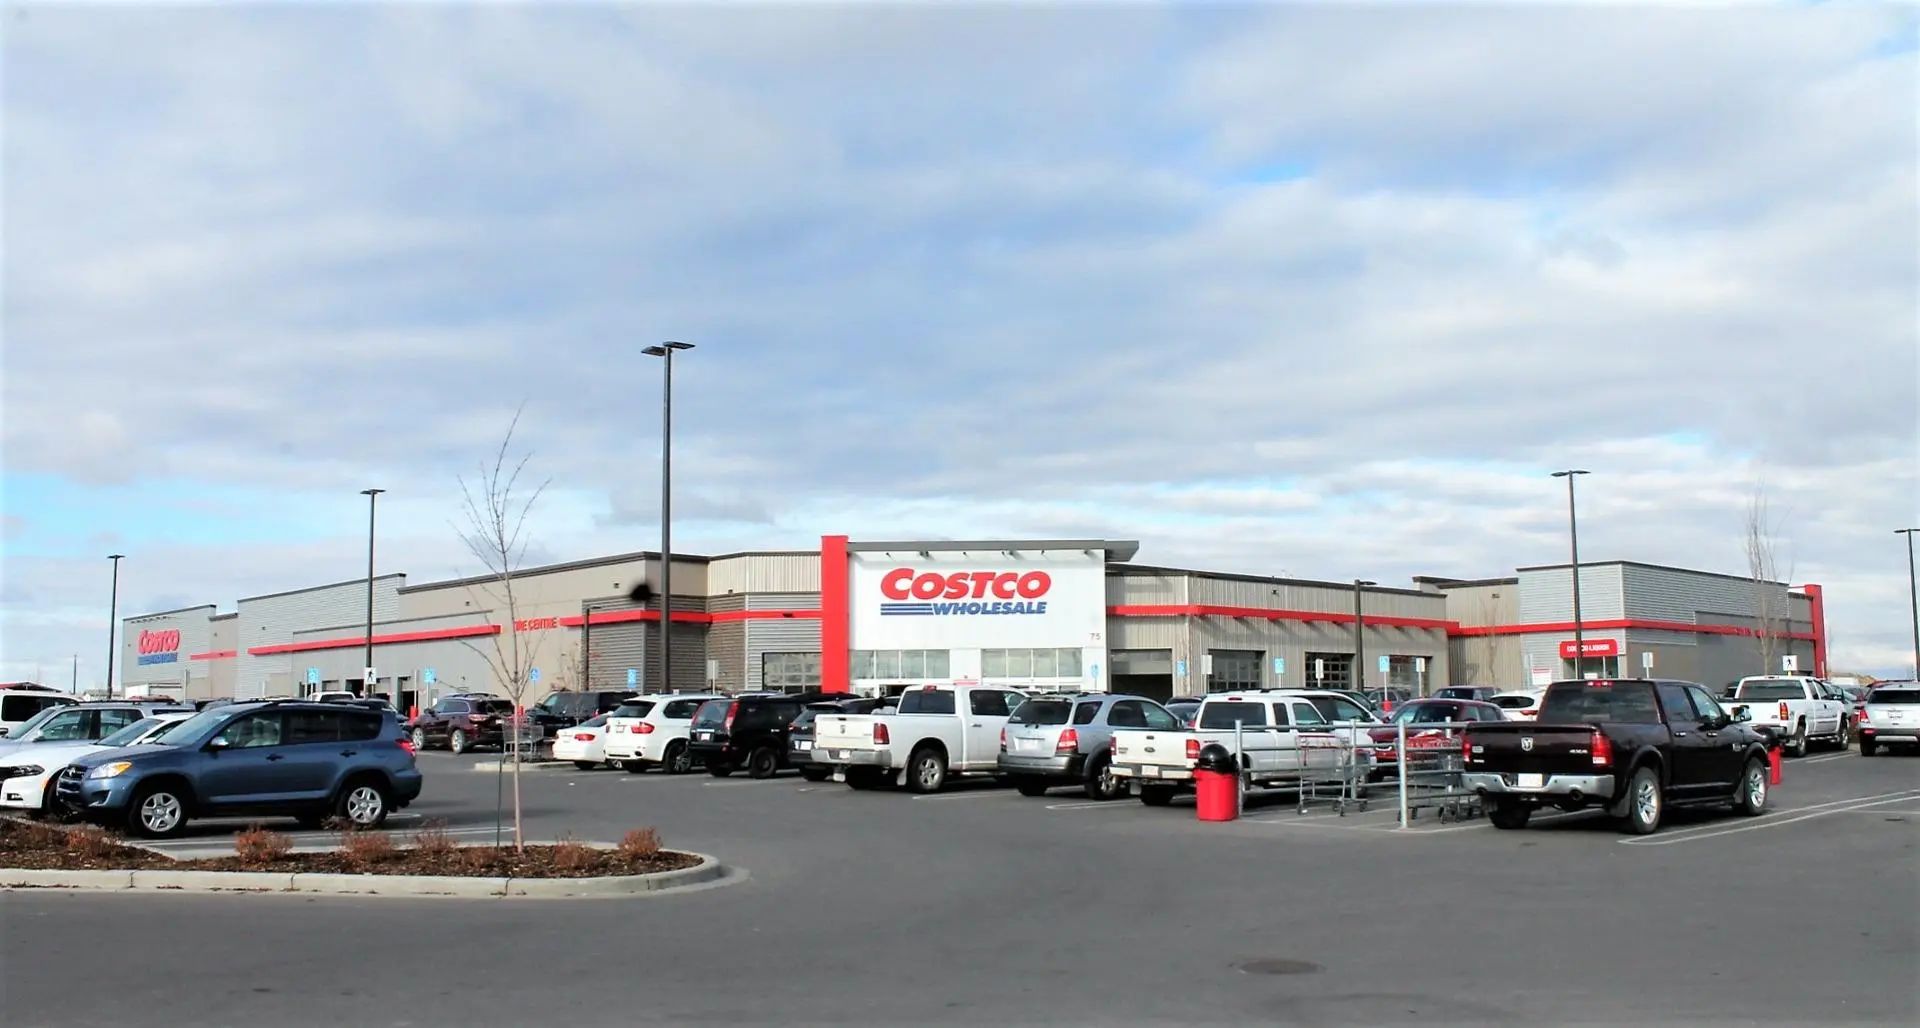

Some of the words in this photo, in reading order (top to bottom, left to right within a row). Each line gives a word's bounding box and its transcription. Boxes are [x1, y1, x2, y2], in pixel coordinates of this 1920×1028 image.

[880, 567, 1052, 601] COSTCO
[932, 601, 1048, 616] WHOLESALE
[528, 617, 558, 632] CENTRE
[138, 629, 180, 655] COSTCO
[1566, 644, 1589, 653] COSCO
